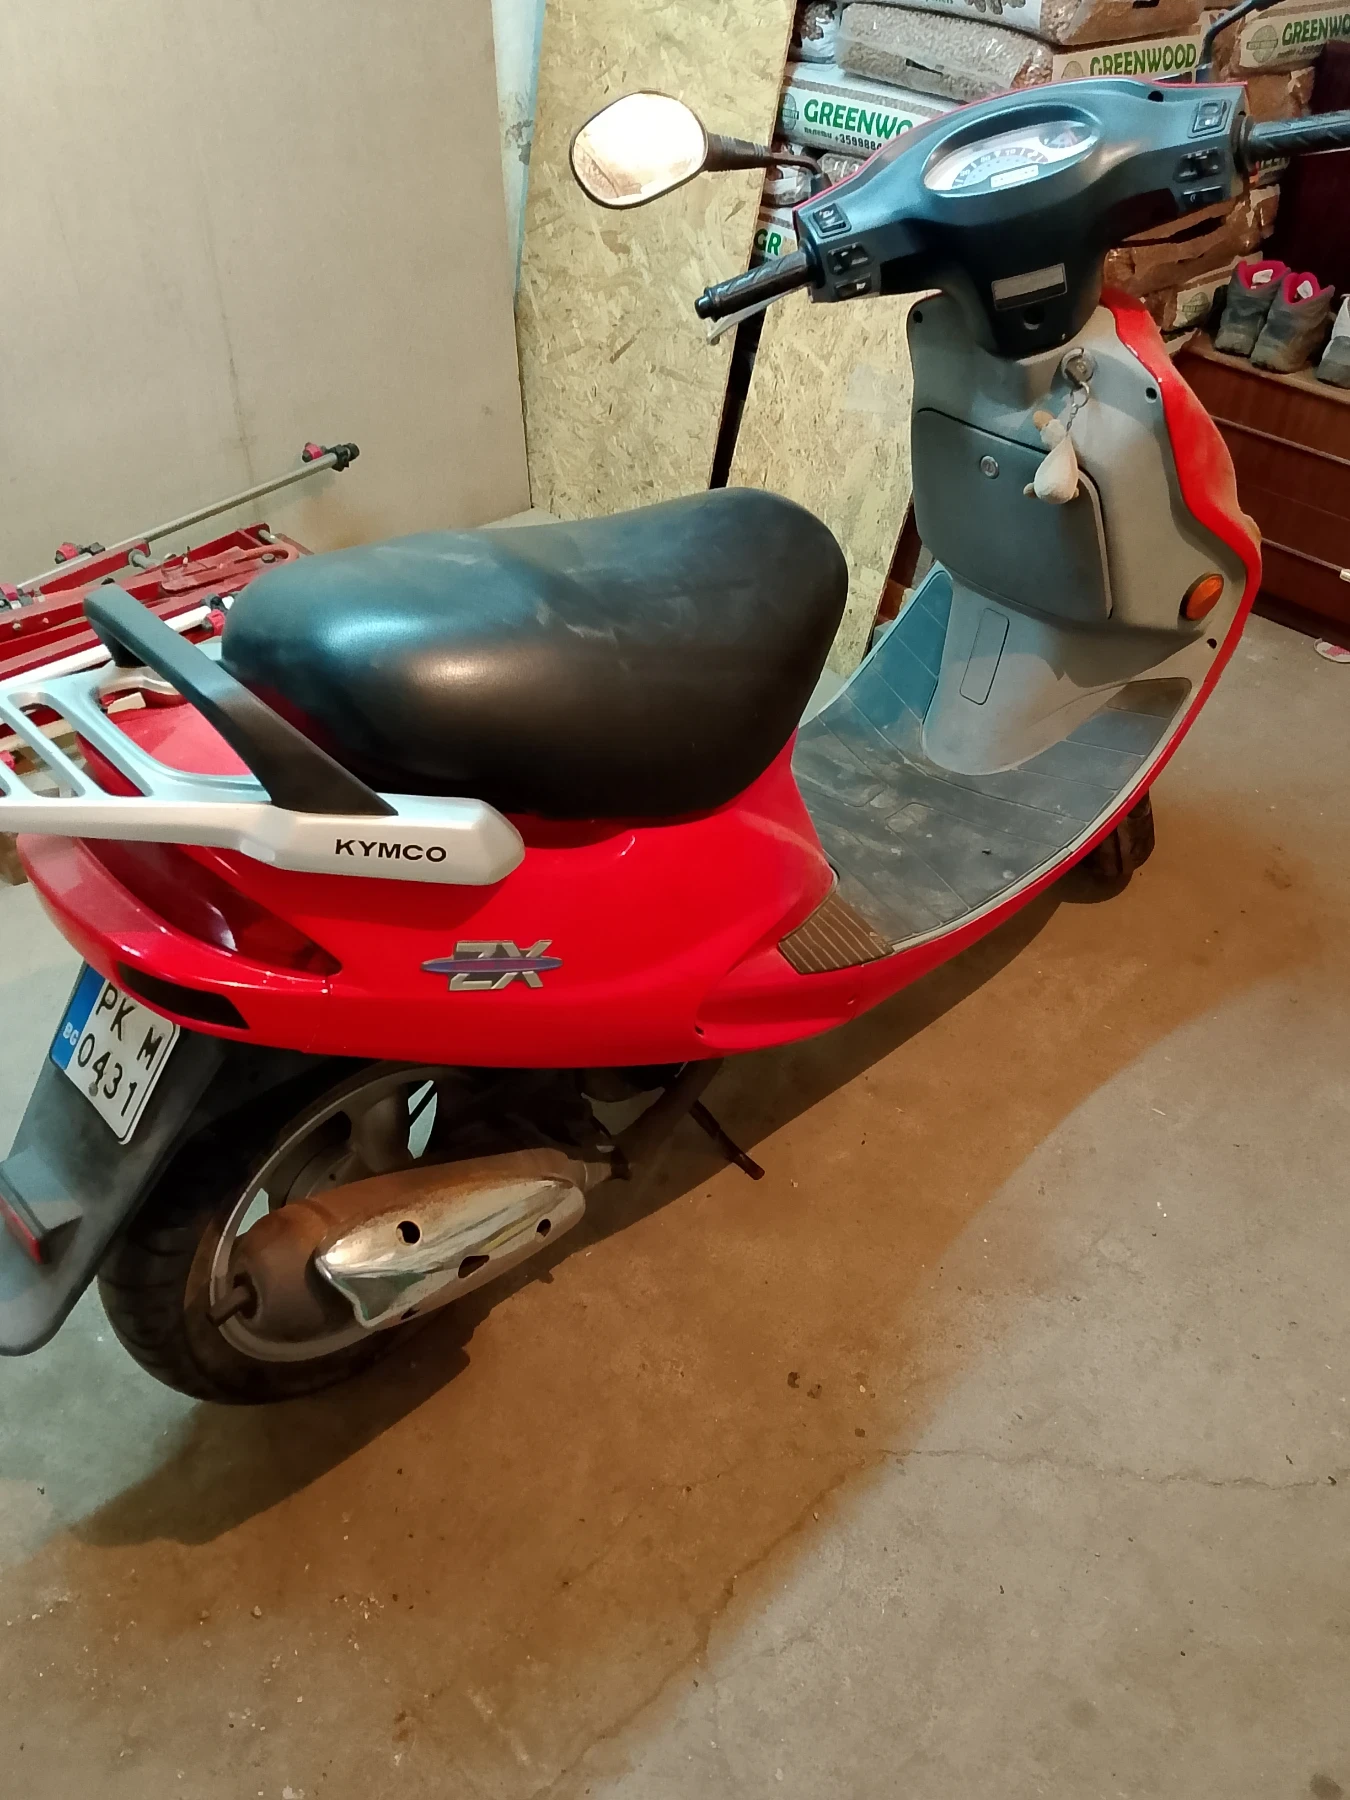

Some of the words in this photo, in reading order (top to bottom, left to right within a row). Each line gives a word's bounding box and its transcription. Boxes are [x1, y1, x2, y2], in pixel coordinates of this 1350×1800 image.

[1090, 43, 1197, 77] GREENWOOD
[335, 838, 447, 863] KYMCO
[449, 940, 553, 991] ZX
[62, 1021, 80, 1046] BG
[136, 1026, 163, 1071] M
[77, 1033, 138, 1117] 0431
